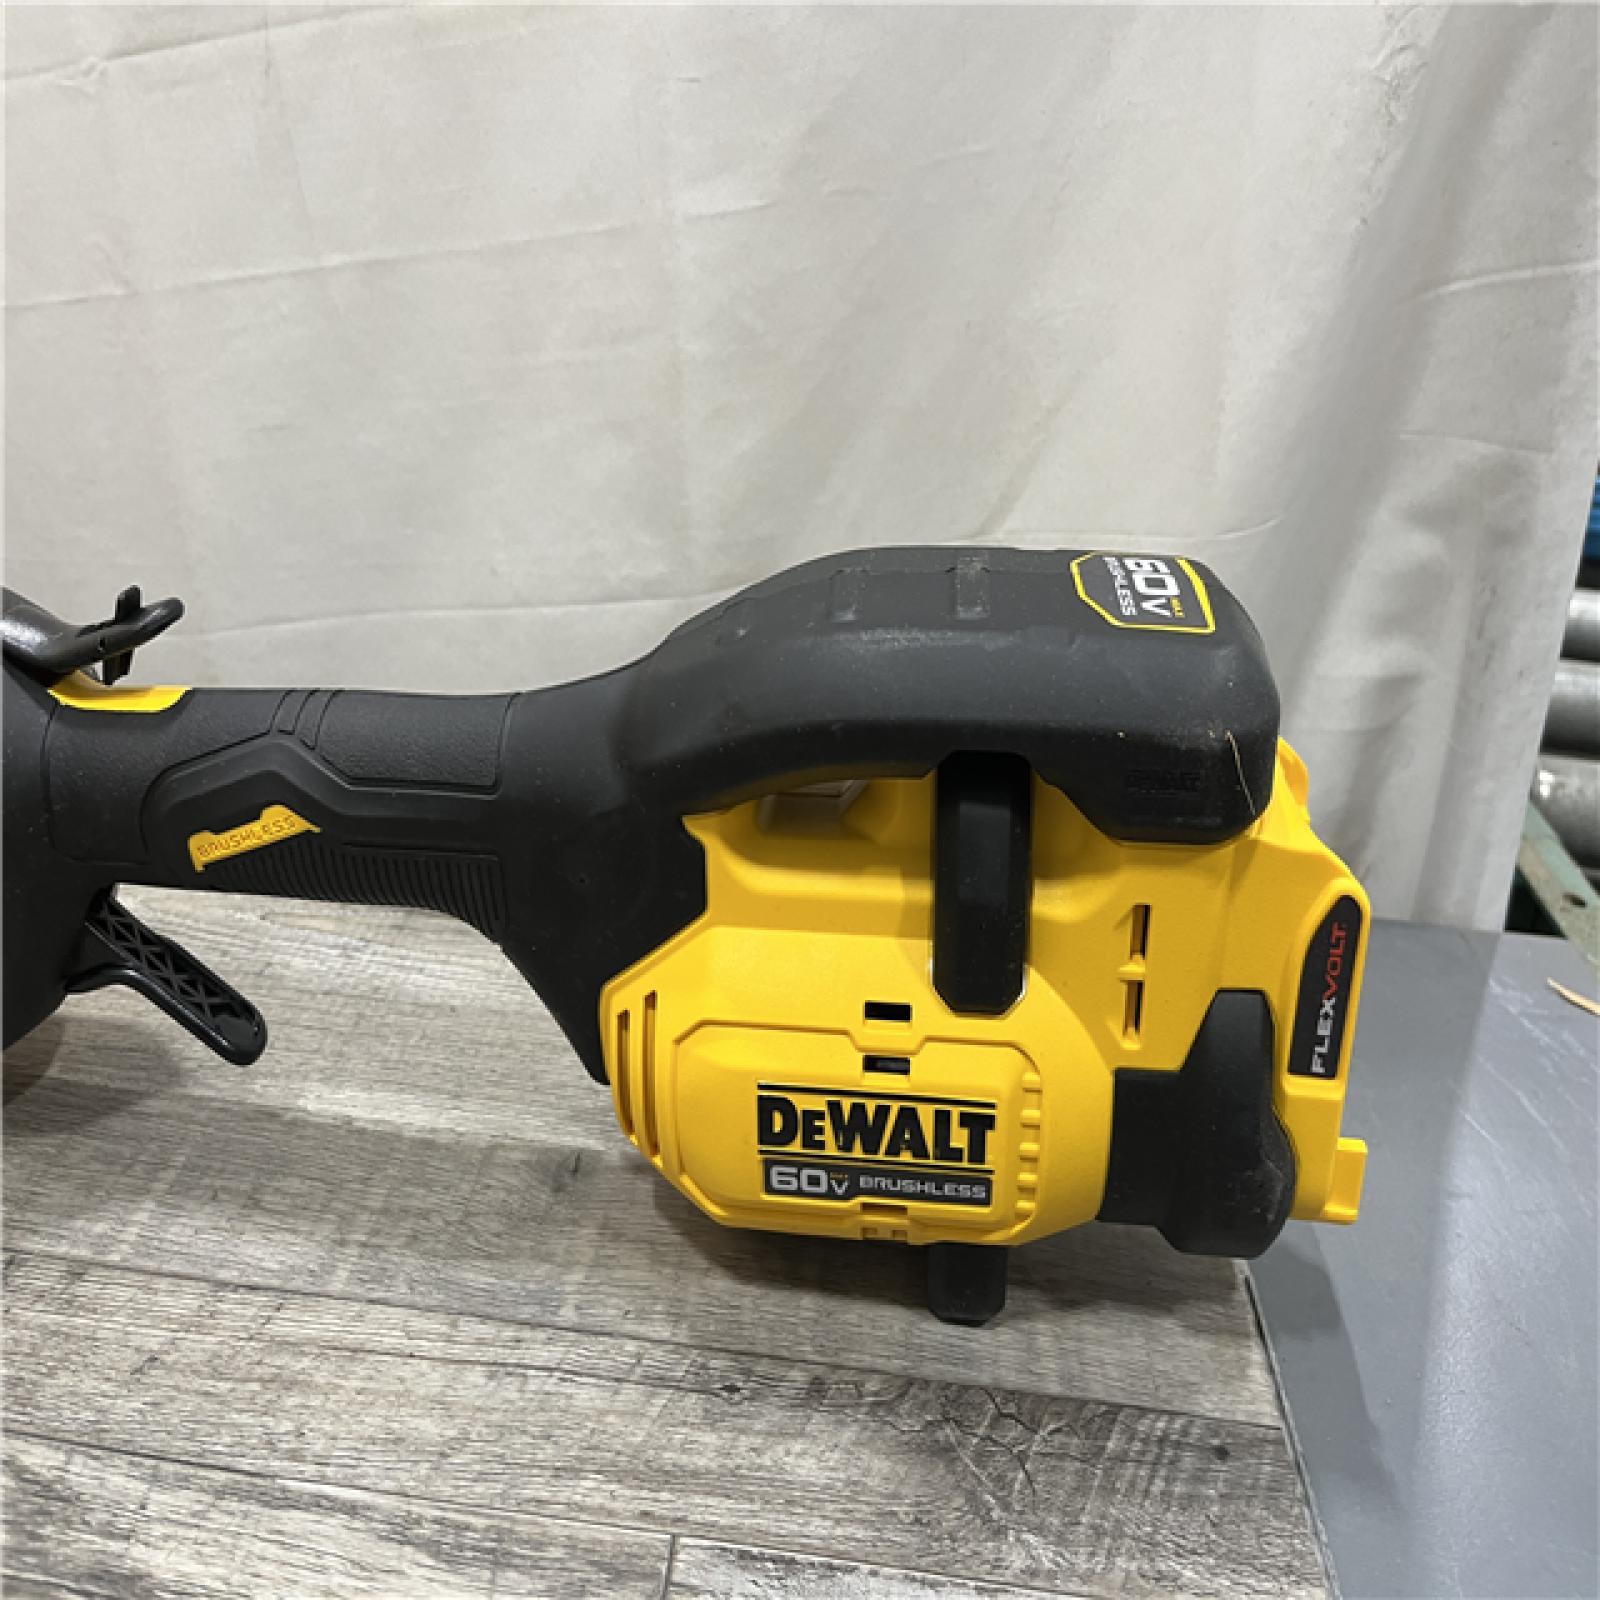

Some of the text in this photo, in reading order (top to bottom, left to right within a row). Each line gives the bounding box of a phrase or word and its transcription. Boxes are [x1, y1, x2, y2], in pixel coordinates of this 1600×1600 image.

[198, 815, 297, 856] BRUSHLESS
[1311, 922, 1347, 1073] FLEXVOLT
[858, 1174, 987, 1199] BRUSHLESS
